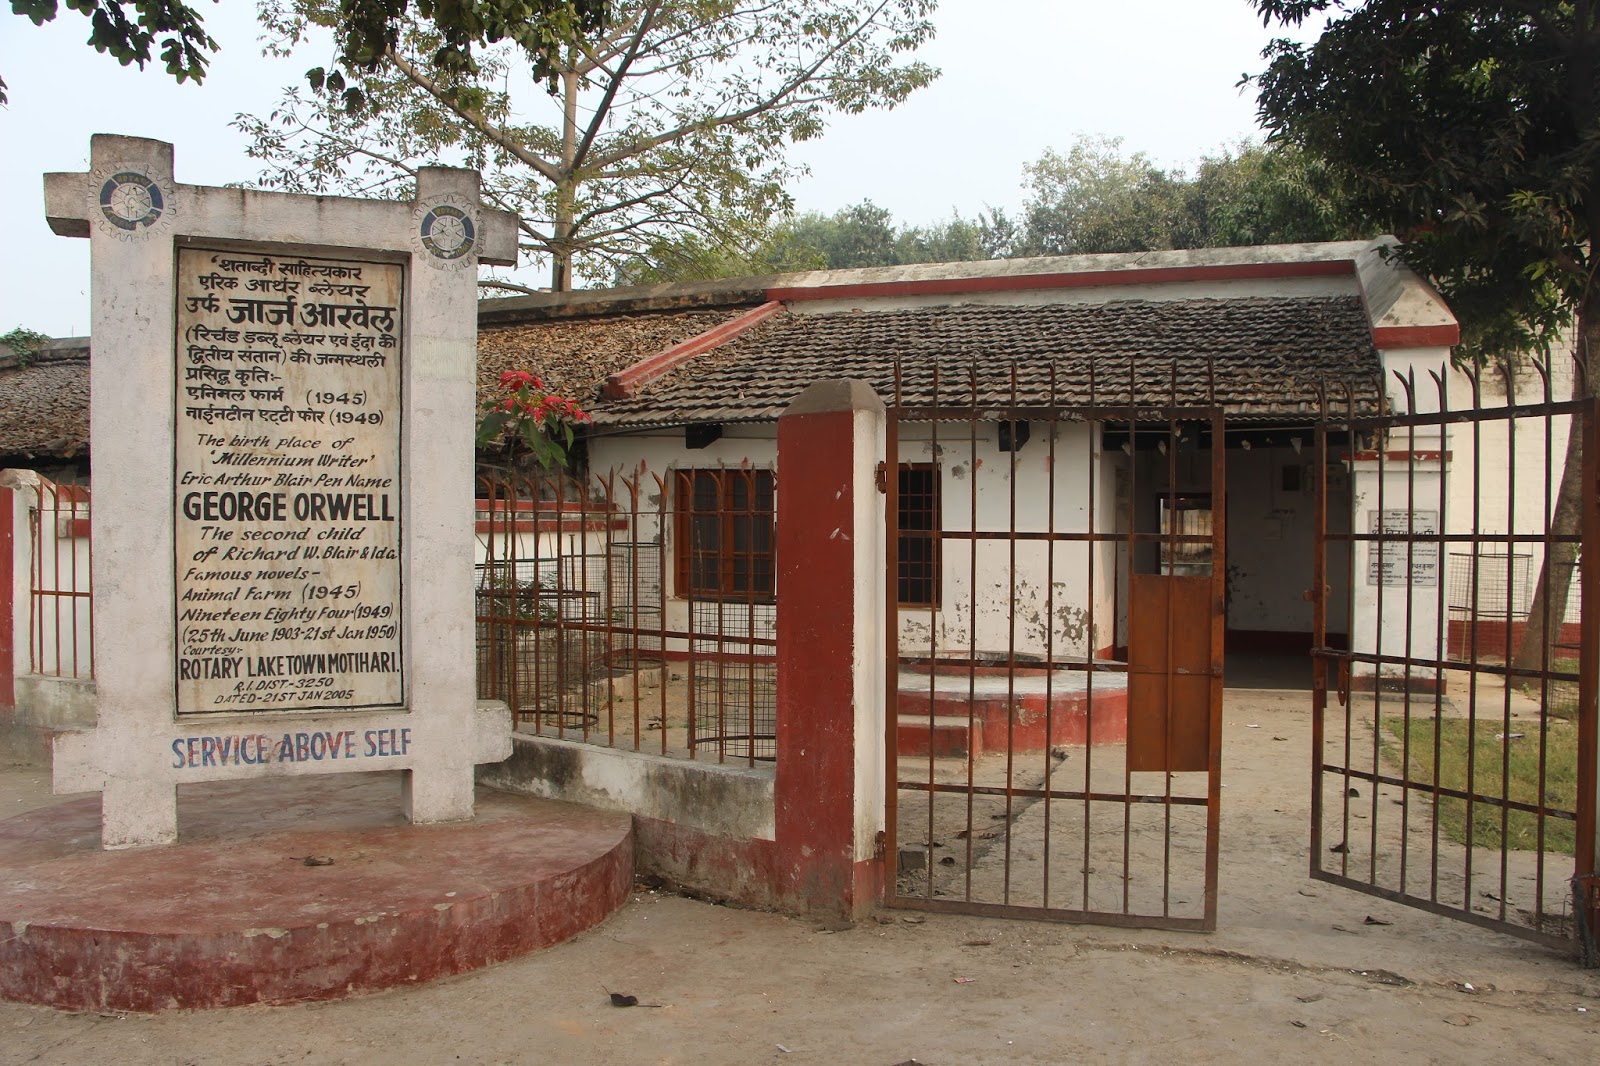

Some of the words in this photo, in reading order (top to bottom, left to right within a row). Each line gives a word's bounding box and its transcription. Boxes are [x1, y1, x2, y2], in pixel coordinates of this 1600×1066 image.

[278, 261, 362, 280] साहित्यकार
[198, 273, 239, 291] एरिक
[245, 277, 301, 294] आर्थर
[308, 280, 371, 298] ब्लेयर
[185, 293, 220, 313] उर्फ
[226, 295, 297, 324] जार्ज
[329, 333, 348, 347] एवं
[378, 333, 397, 349] की
[187, 344, 234, 365] द्वितीय
[290, 348, 311, 364] की
[185, 366, 231, 386] प्रसिद्ध
[186, 384, 246, 401] एनिमल
[249, 386, 284, 402] फार्म
[306, 389, 367, 406] (1945)
[297, 407, 325, 424] फोर
[329, 408, 384, 427] (1949)
[197, 433, 225, 447] The
[228, 435, 270, 448] birth
[275, 436, 322, 450] place
[331, 437, 355, 449] of
[181, 471, 213, 486] Eric
[214, 472, 272, 487] Arthur
[273, 473, 313, 487] Blair
[313, 475, 344, 487] Pen
[344, 474, 392, 488] Name
[183, 491, 287, 522] GEORGE
[293, 492, 395, 522] ORWELL
[200, 525, 234, 541] The
[240, 527, 311, 541] second
[316, 526, 367, 540] child
[192, 546, 218, 563] of
[221, 546, 302, 561] Richard
[183, 567, 251, 581] Famous
[181, 587, 241, 601] Animal
[244, 587, 292, 600] Farm
[301, 581, 362, 604] (1945)
[180, 607, 262, 622] Nineteen
[263, 607, 318, 624] Eighty
[182, 626, 226, 645] (25th
[228, 628, 268, 643] June
[336, 627, 366, 640] Jan
[366, 621, 398, 641] 1950)
[180, 657, 243, 681] ROTARY
[247, 656, 284, 677] LAKE
[286, 654, 326, 675] TOWN
[297, 690, 322, 701] JAN
[325, 689, 355, 701] 2005
[172, 734, 271, 769] SERVICE
[278, 729, 356, 763] ABOVE
[363, 728, 412, 758] SELF
